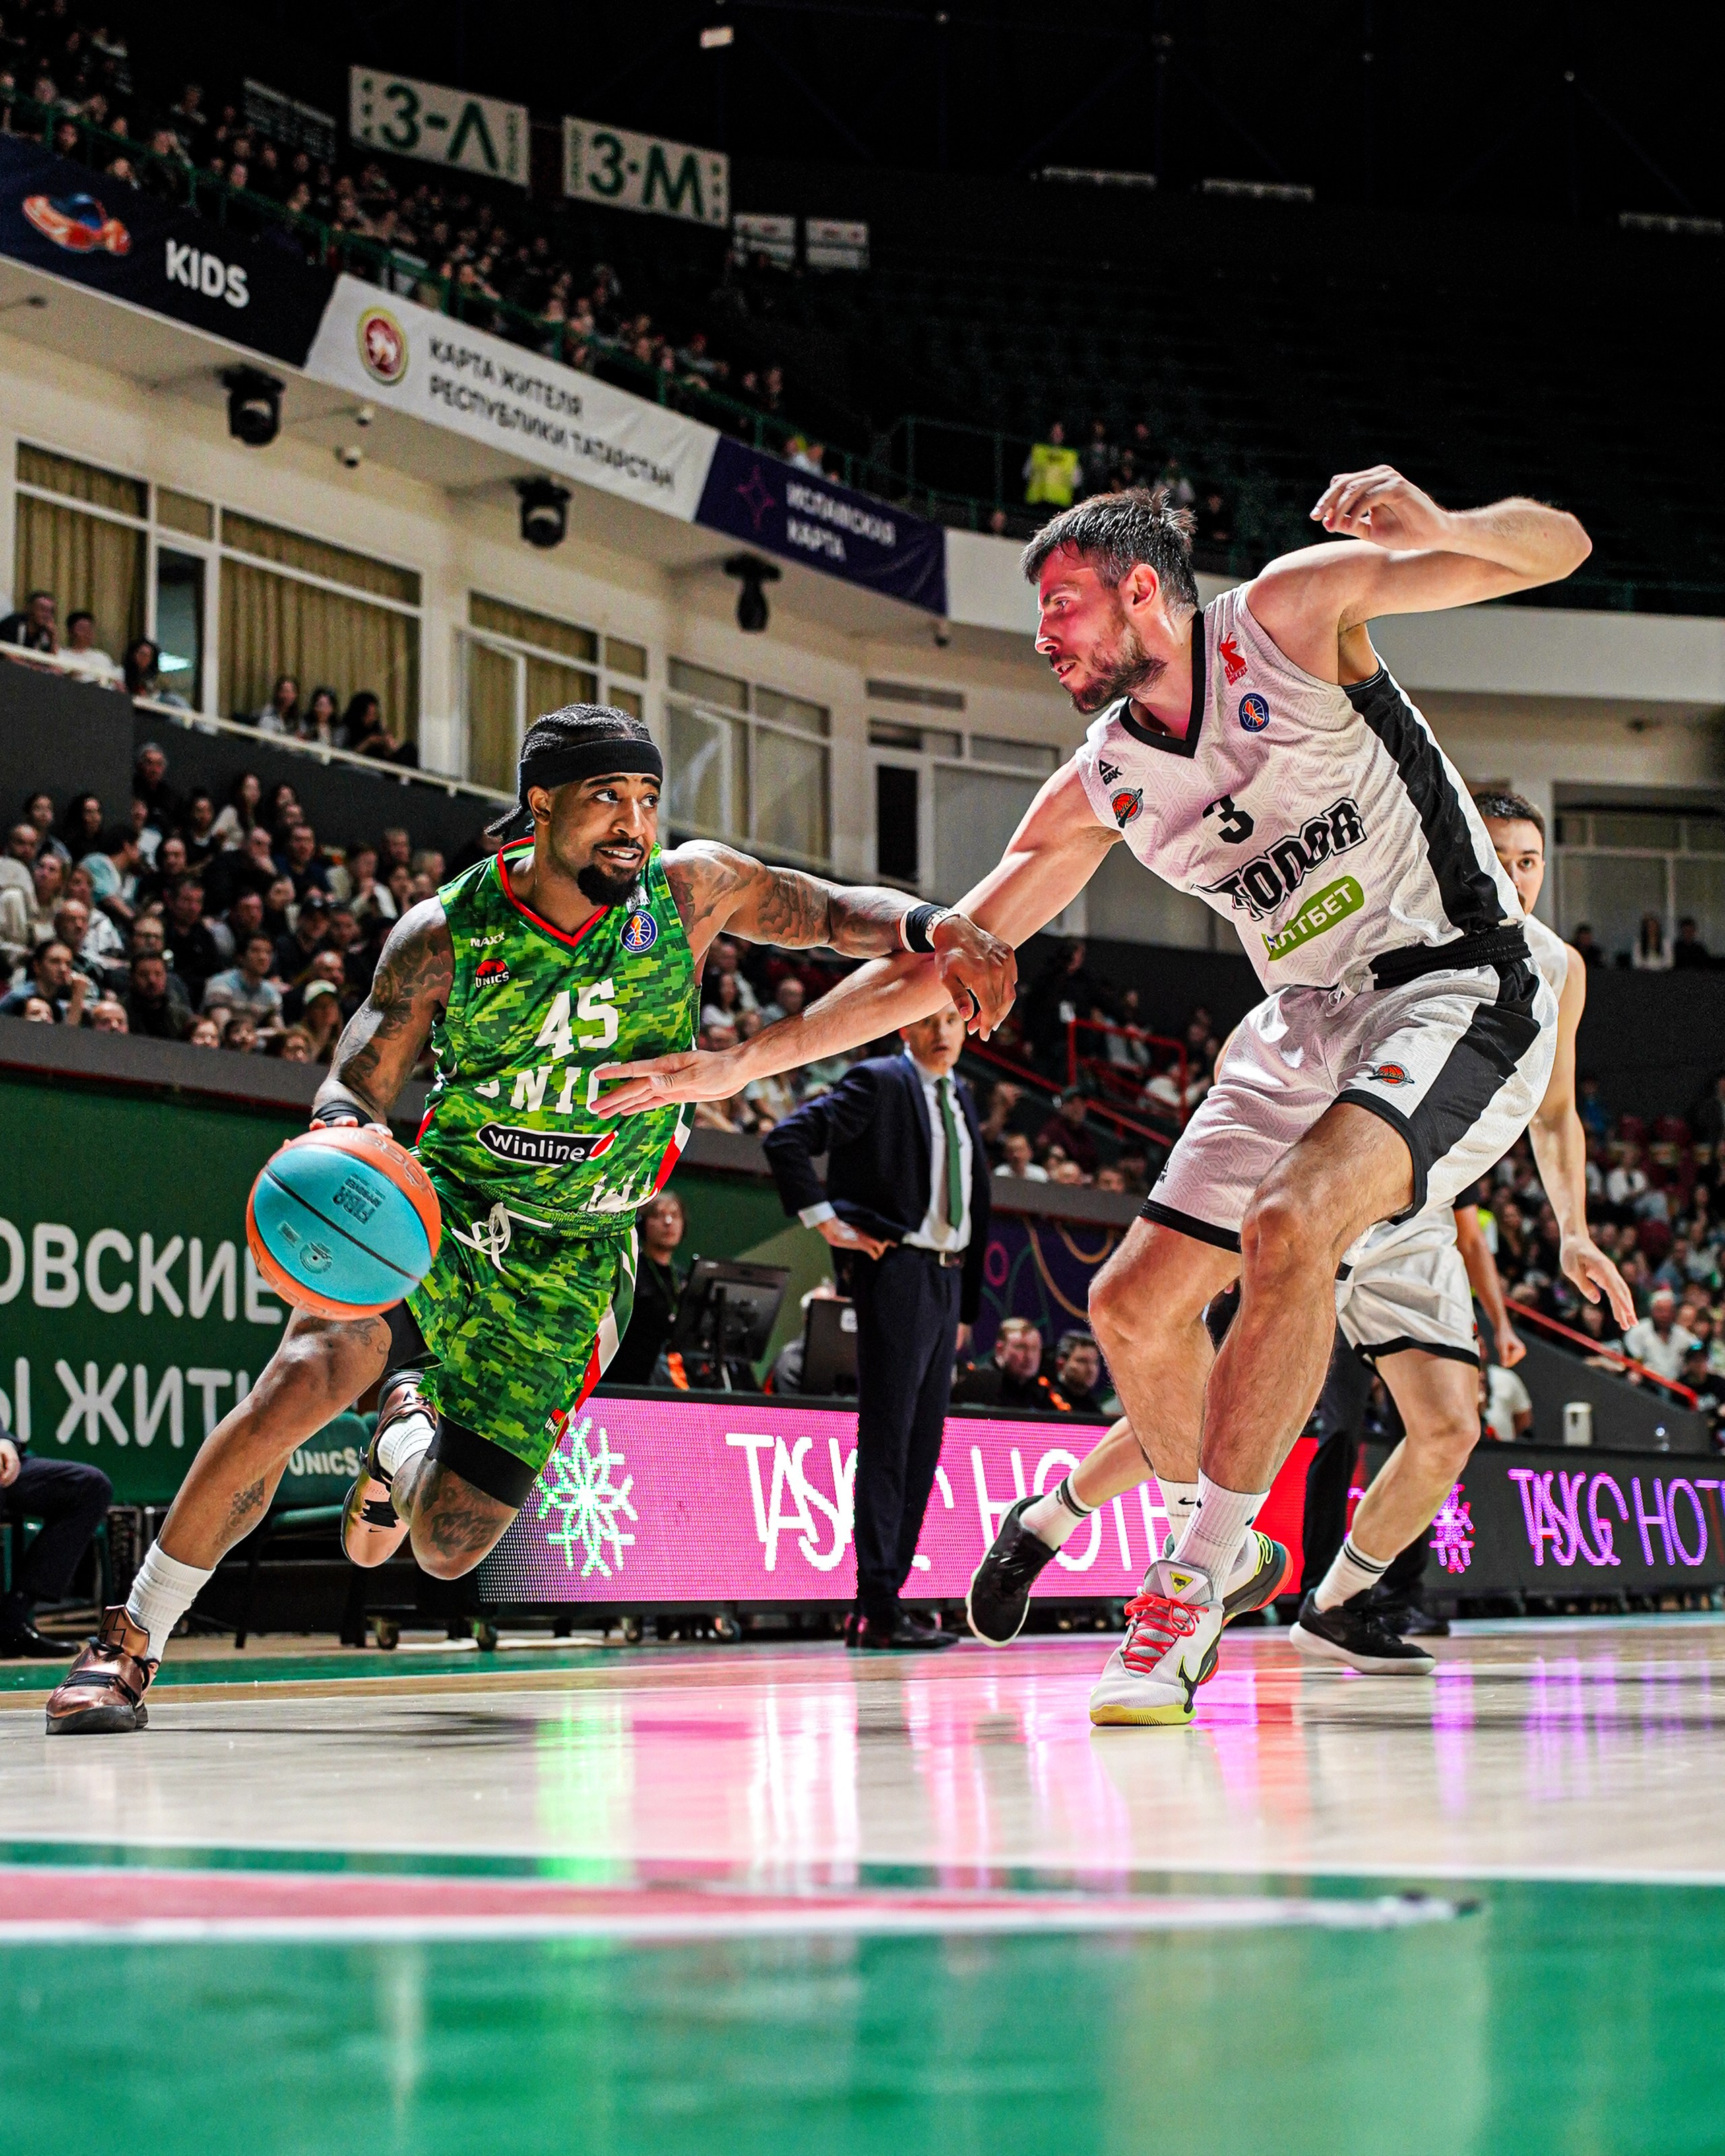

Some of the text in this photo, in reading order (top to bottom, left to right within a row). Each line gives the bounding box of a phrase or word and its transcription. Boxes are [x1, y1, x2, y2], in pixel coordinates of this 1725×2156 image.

[166, 238, 250, 309] KIDS
[429, 337, 584, 419] КАРТА ЖИТЕЛЯ
[429, 375, 676, 492] РЕСПУБЛИКИ ТАТАРСТАН
[786, 516, 847, 562] КАРТА
[1102, 765, 1123, 786] EAK
[1202, 794, 1254, 844] 3
[470, 932, 505, 947] MAXX
[475, 971, 509, 988] UNICS
[534, 978, 619, 1060] 45
[489, 1129, 585, 1161] Winline
[288, 1447, 360, 1477] UNICS
[1631, 1476, 1725, 1566] HOT
